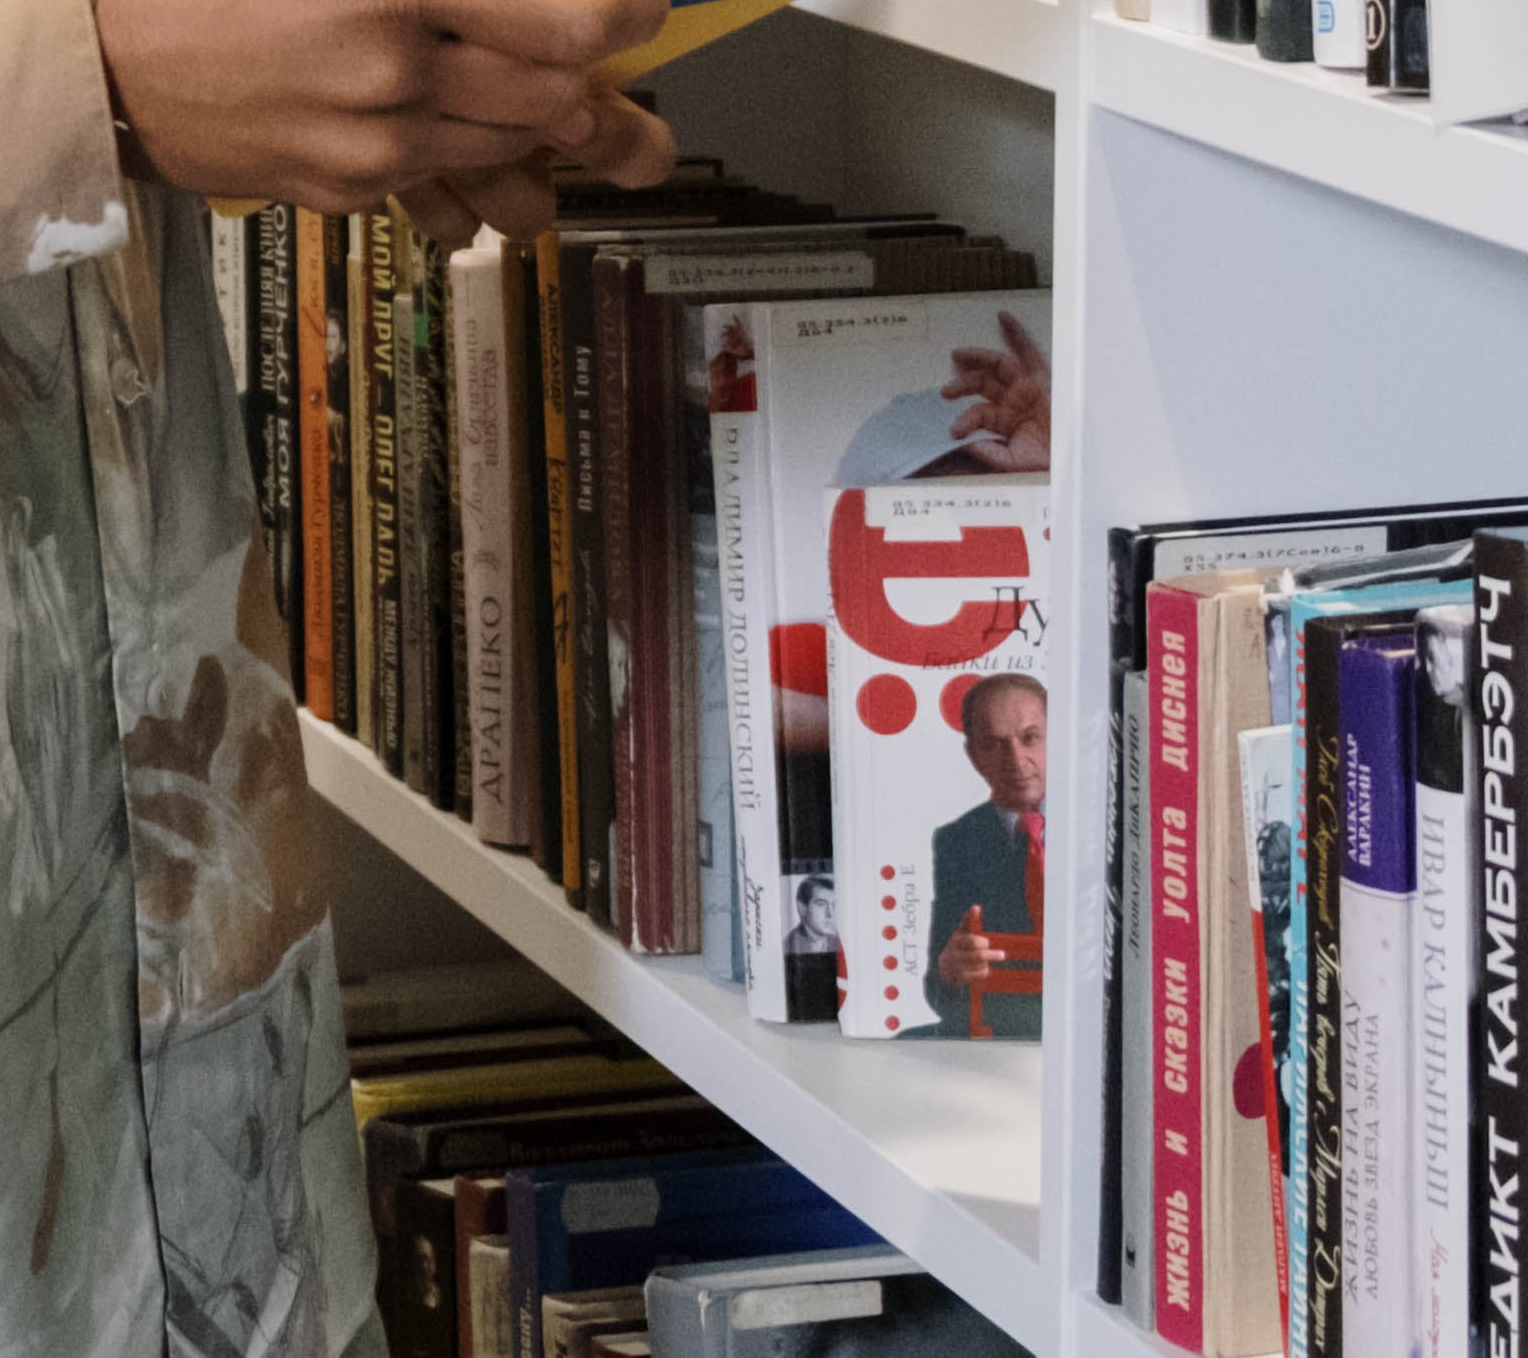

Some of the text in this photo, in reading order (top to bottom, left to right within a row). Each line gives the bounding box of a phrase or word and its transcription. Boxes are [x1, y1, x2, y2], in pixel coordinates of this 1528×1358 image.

[273, 206, 290, 507] МОЯ ГУРЧЕНКО
[478, 596, 505, 804] ДРАПЕКО
[1479, 574, 1520, 1087] КАМБЕРБЭТЧ
[1422, 813, 1446, 929] ИВАР
[1363, 1013, 1380, 1300] ЛЮБОВЬ ЗВЕЗД ЭКРАНА
